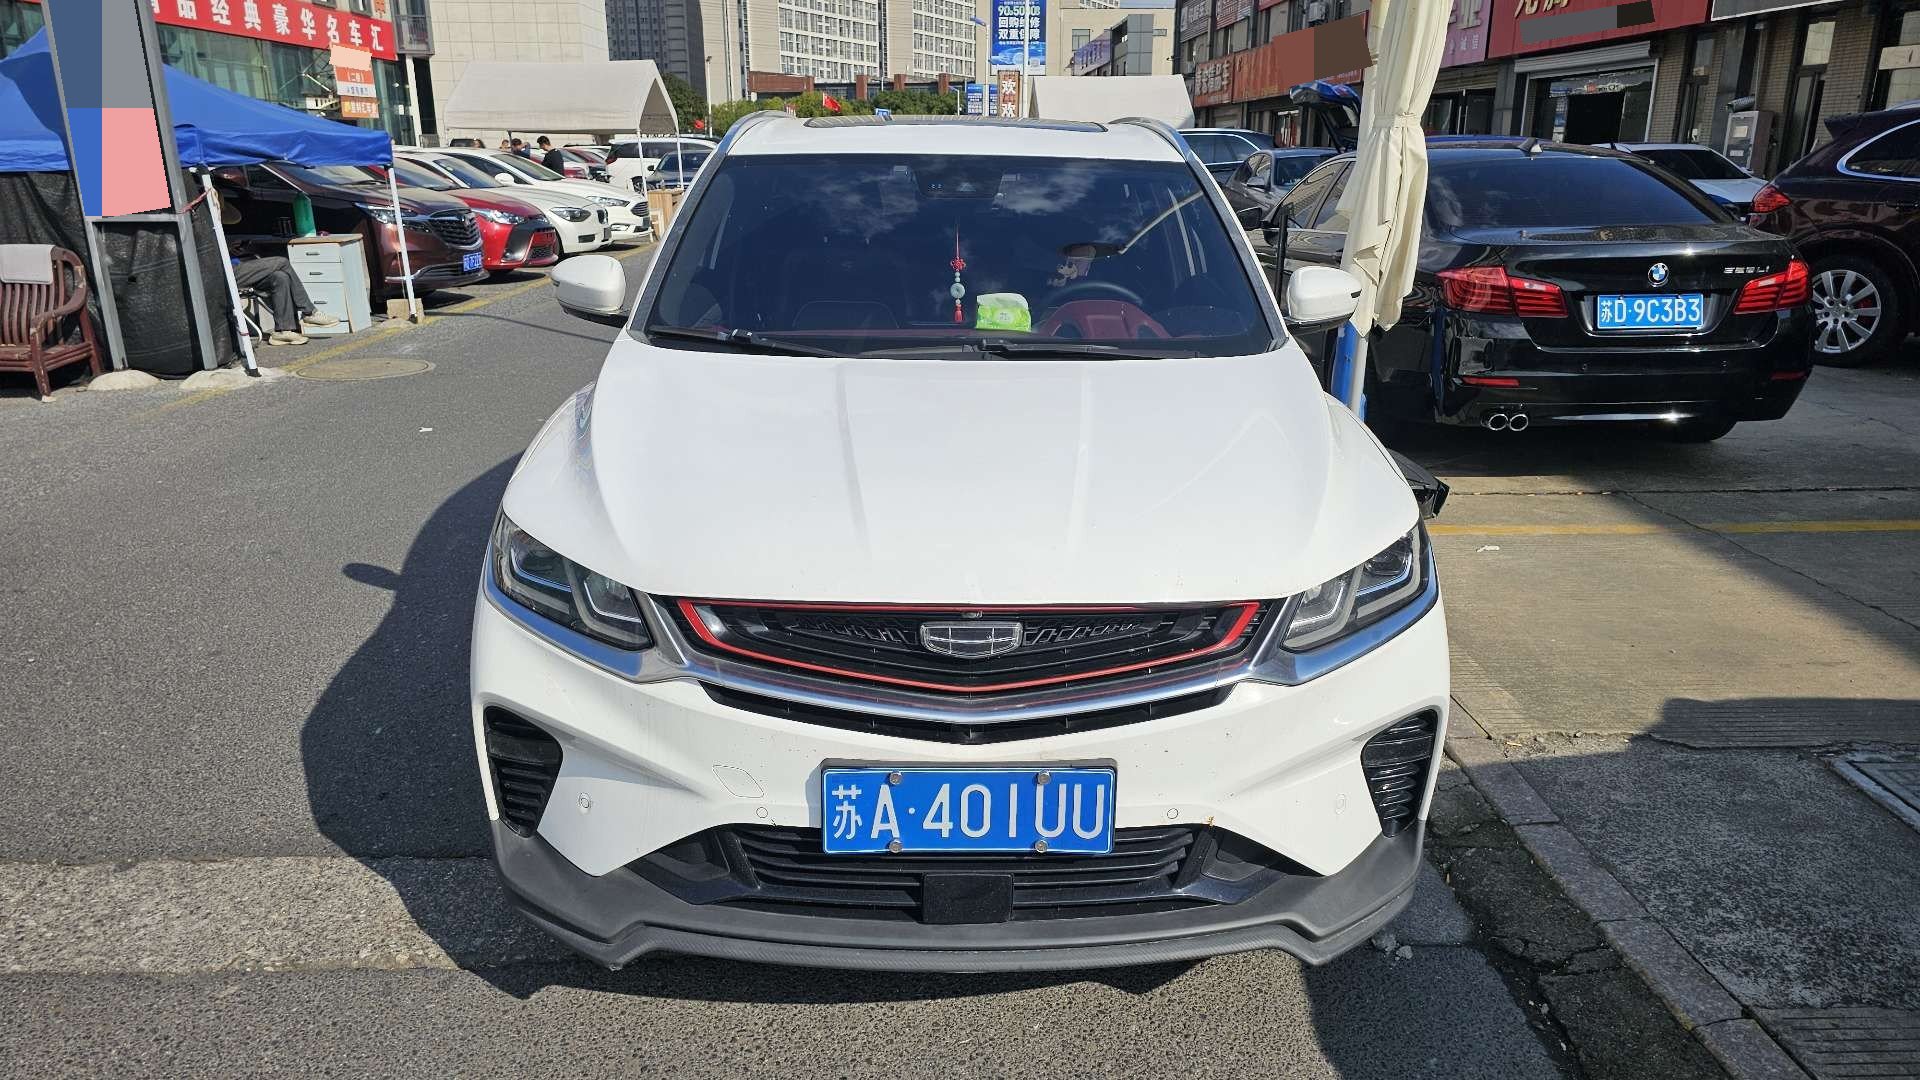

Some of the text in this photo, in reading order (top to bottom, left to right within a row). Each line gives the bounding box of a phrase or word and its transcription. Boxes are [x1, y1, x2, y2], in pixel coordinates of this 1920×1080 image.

[152, 0, 384, 51] 品经典豪华名车汇
[1600, 298, 1700, 323] 苏D·9C3B3
[831, 783, 1105, 840] 苏A·401UU
